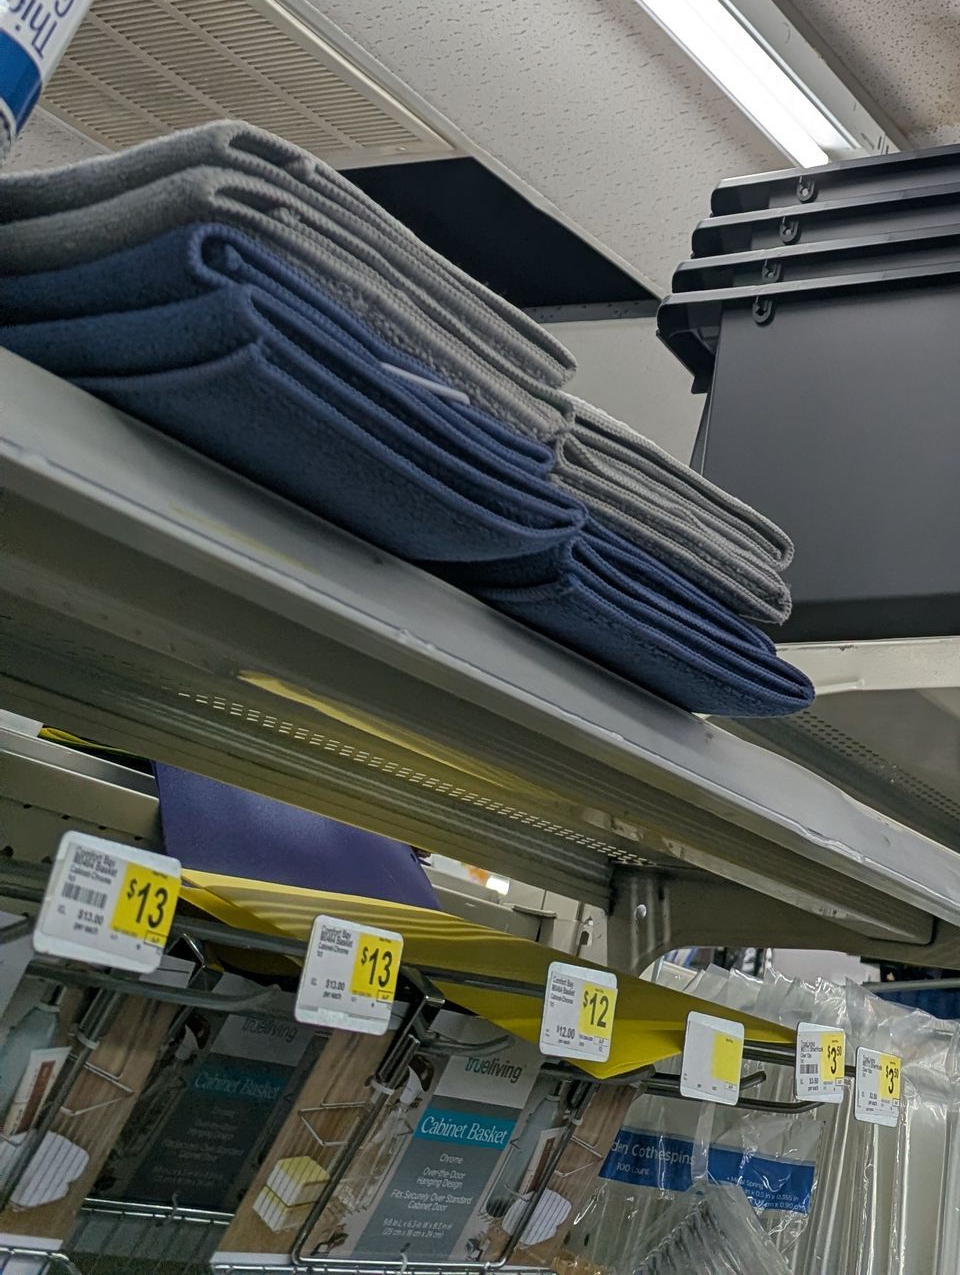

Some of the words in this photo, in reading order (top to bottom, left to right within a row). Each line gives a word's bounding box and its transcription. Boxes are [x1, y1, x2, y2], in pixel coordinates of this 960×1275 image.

[126, 877, 169, 929] $13
[77, 908, 105, 925] $13.00
[361, 946, 393, 988] $13
[325, 978, 346, 992] $13.00
[582, 989, 610, 1029] $12
[556, 1024, 576, 1040] $12.00
[465, 1056, 524, 1084] trueliving
[420, 1115, 468, 1140] Cabinet
[467, 1121, 509, 1146] Basket
[439, 1152, 465, 1165] Chrome
[422, 1166, 466, 1180] Over-the-Door
[416, 1176, 442, 1188] Hanging
[441, 1178, 464, 1191] Design
[746, 1180, 764, 1191] Spring
[403, 1189, 430, 1203] Securely
[429, 1192, 446, 1203] Over
[445, 1193, 474, 1205] Standard
[407, 1200, 434, 1211] Cabinet
[433, 1202, 449, 1212] Door
